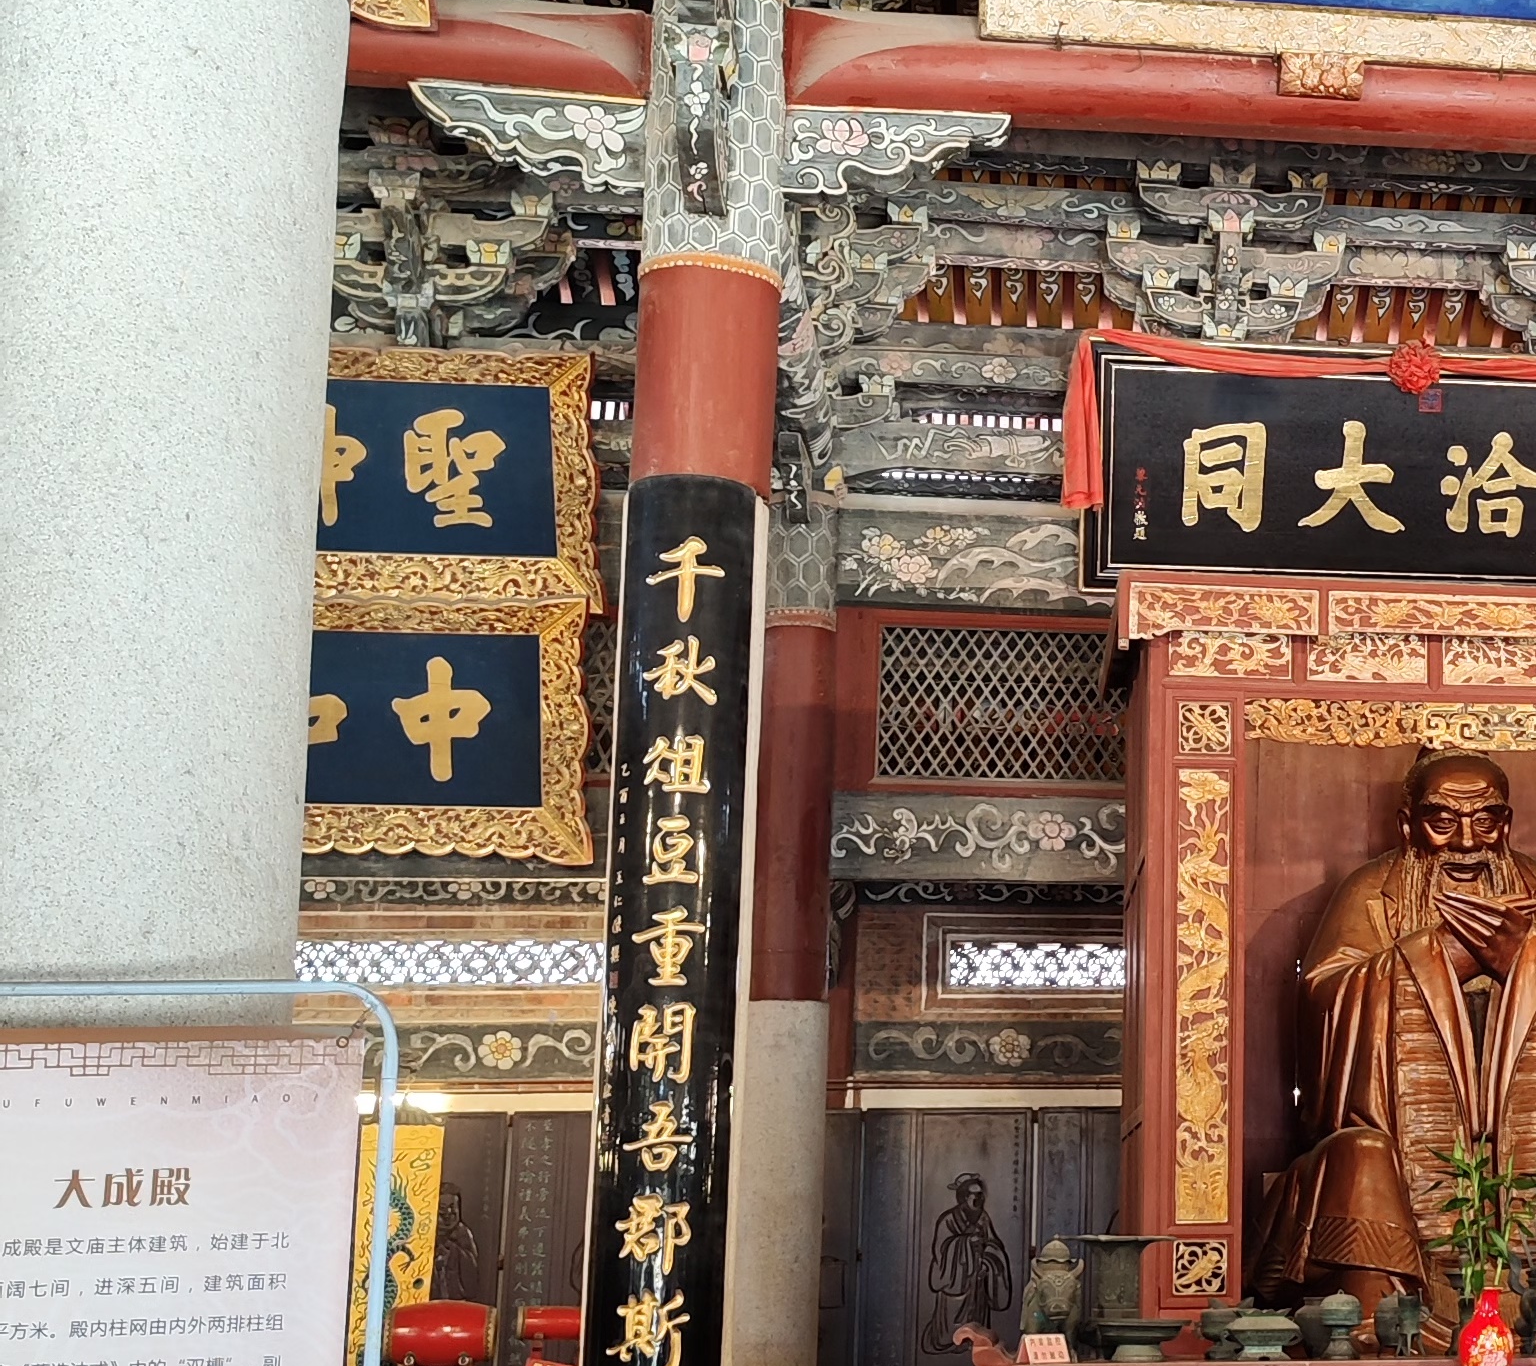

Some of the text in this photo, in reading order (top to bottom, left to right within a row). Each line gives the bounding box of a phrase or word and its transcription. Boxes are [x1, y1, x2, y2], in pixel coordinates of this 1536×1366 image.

[53, 1167, 192, 1209] 大成殿
[0, 1273, 287, 1299] 阔七间，进深五间，建筑面积
